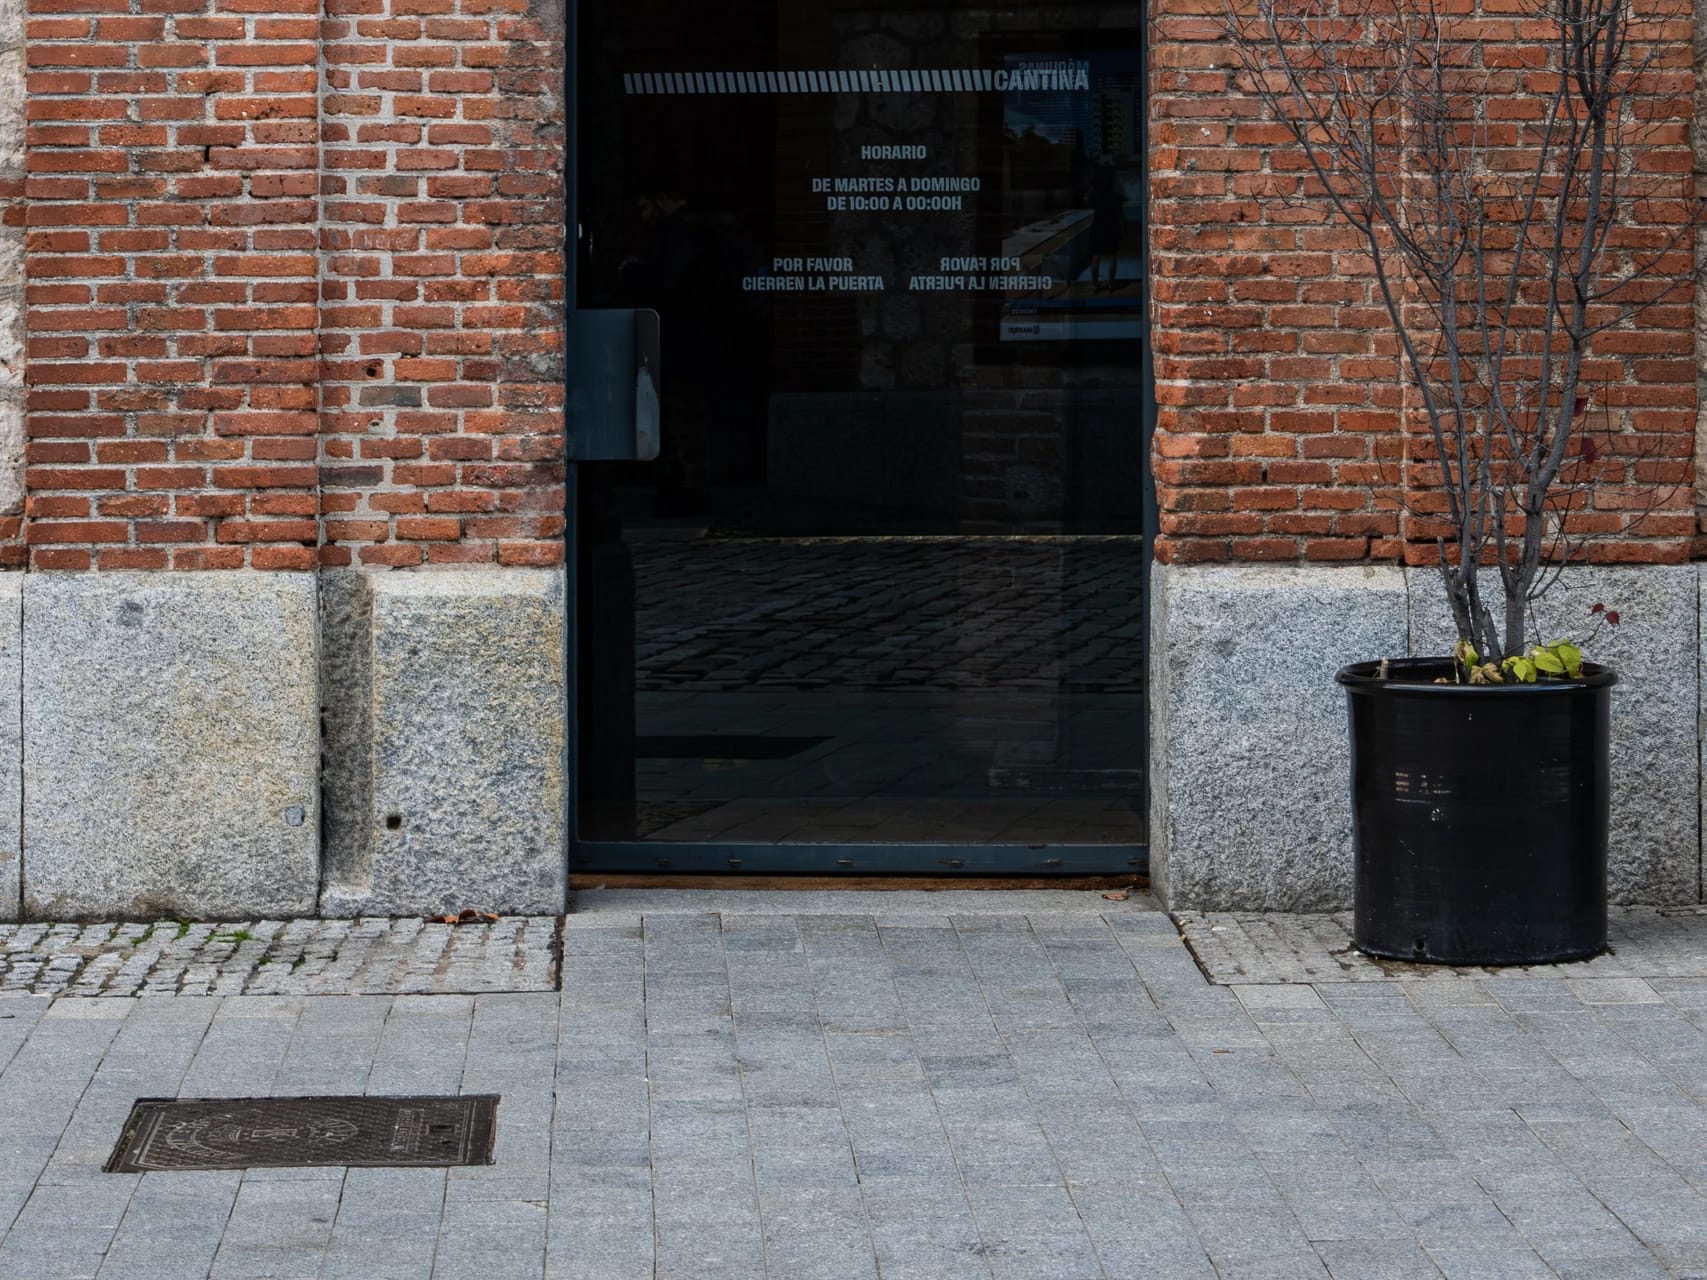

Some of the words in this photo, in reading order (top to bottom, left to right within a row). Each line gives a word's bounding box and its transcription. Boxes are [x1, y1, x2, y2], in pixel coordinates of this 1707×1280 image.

[993, 69, 1090, 92] CANTINA
[860, 145, 928, 160] HORARIO
[811, 177, 832, 193] DE
[834, 177, 895, 193] MARTES
[896, 177, 908, 192] A
[910, 177, 981, 193] DOMINGO
[826, 196, 847, 211] DE
[849, 196, 890, 211] 10:00
[892, 196, 904, 211] A
[905, 196, 962, 211] 00:00H
[773, 257, 804, 273] POR
[807, 257, 854, 273] FAVOR
[741, 276, 806, 292] CIERREN
[808, 276, 826, 292] LA
[828, 276, 885, 292] PUERTA
